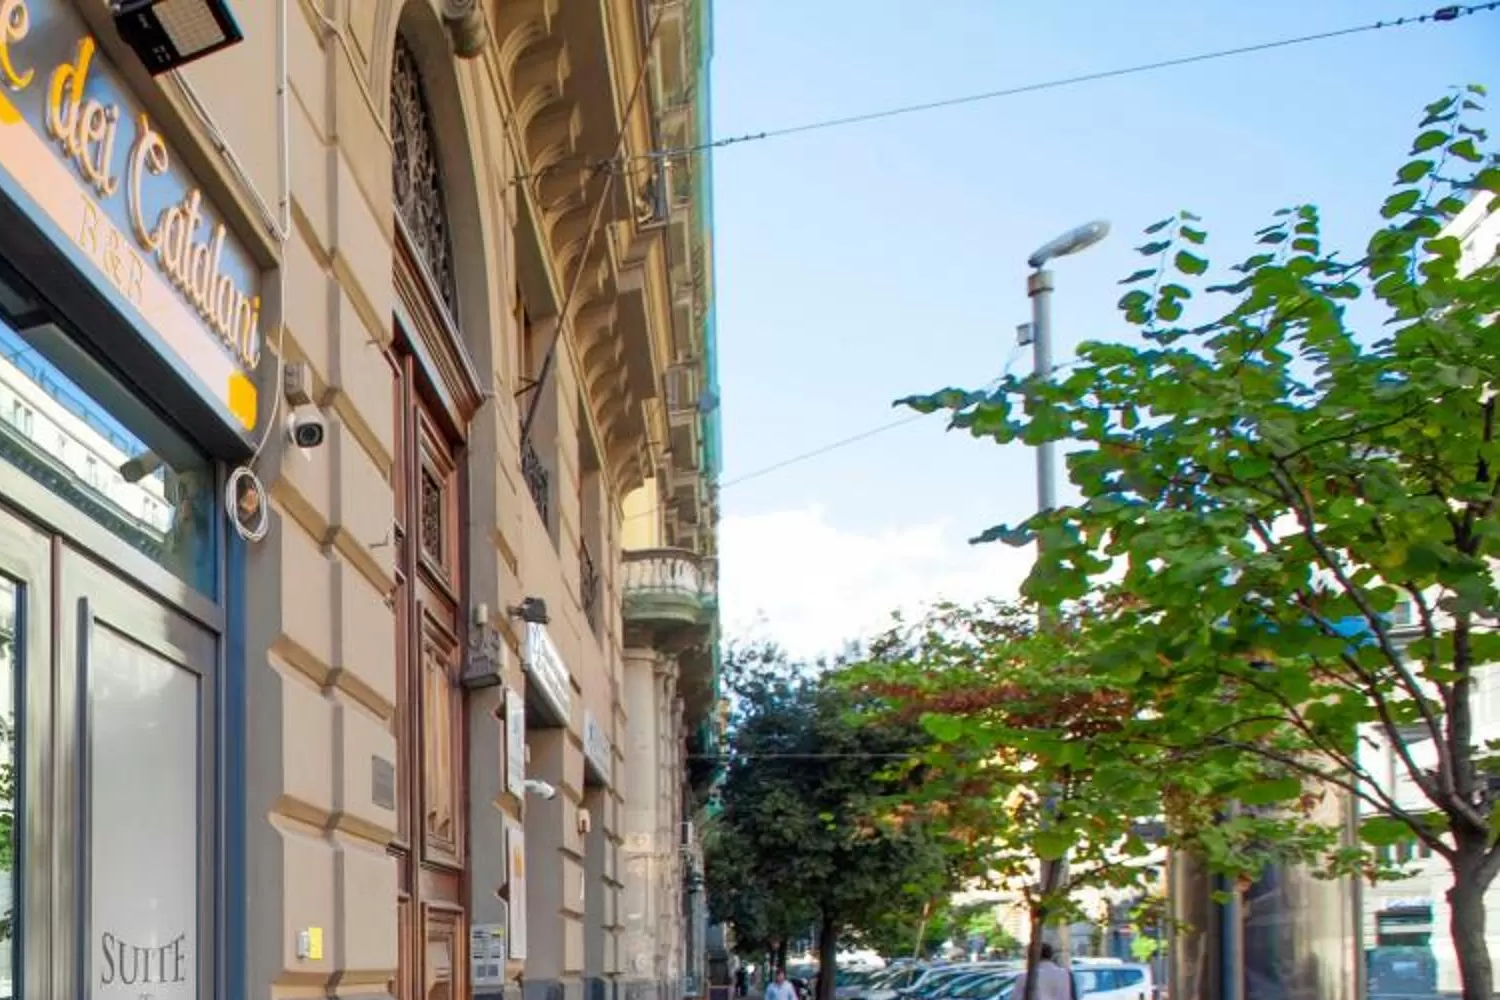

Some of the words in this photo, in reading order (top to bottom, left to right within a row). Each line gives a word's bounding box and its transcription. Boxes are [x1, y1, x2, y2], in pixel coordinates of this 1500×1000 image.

[47, 32, 120, 198] dei
[127, 112, 262, 370] Catalani
[101, 931, 185, 985] SUITE
